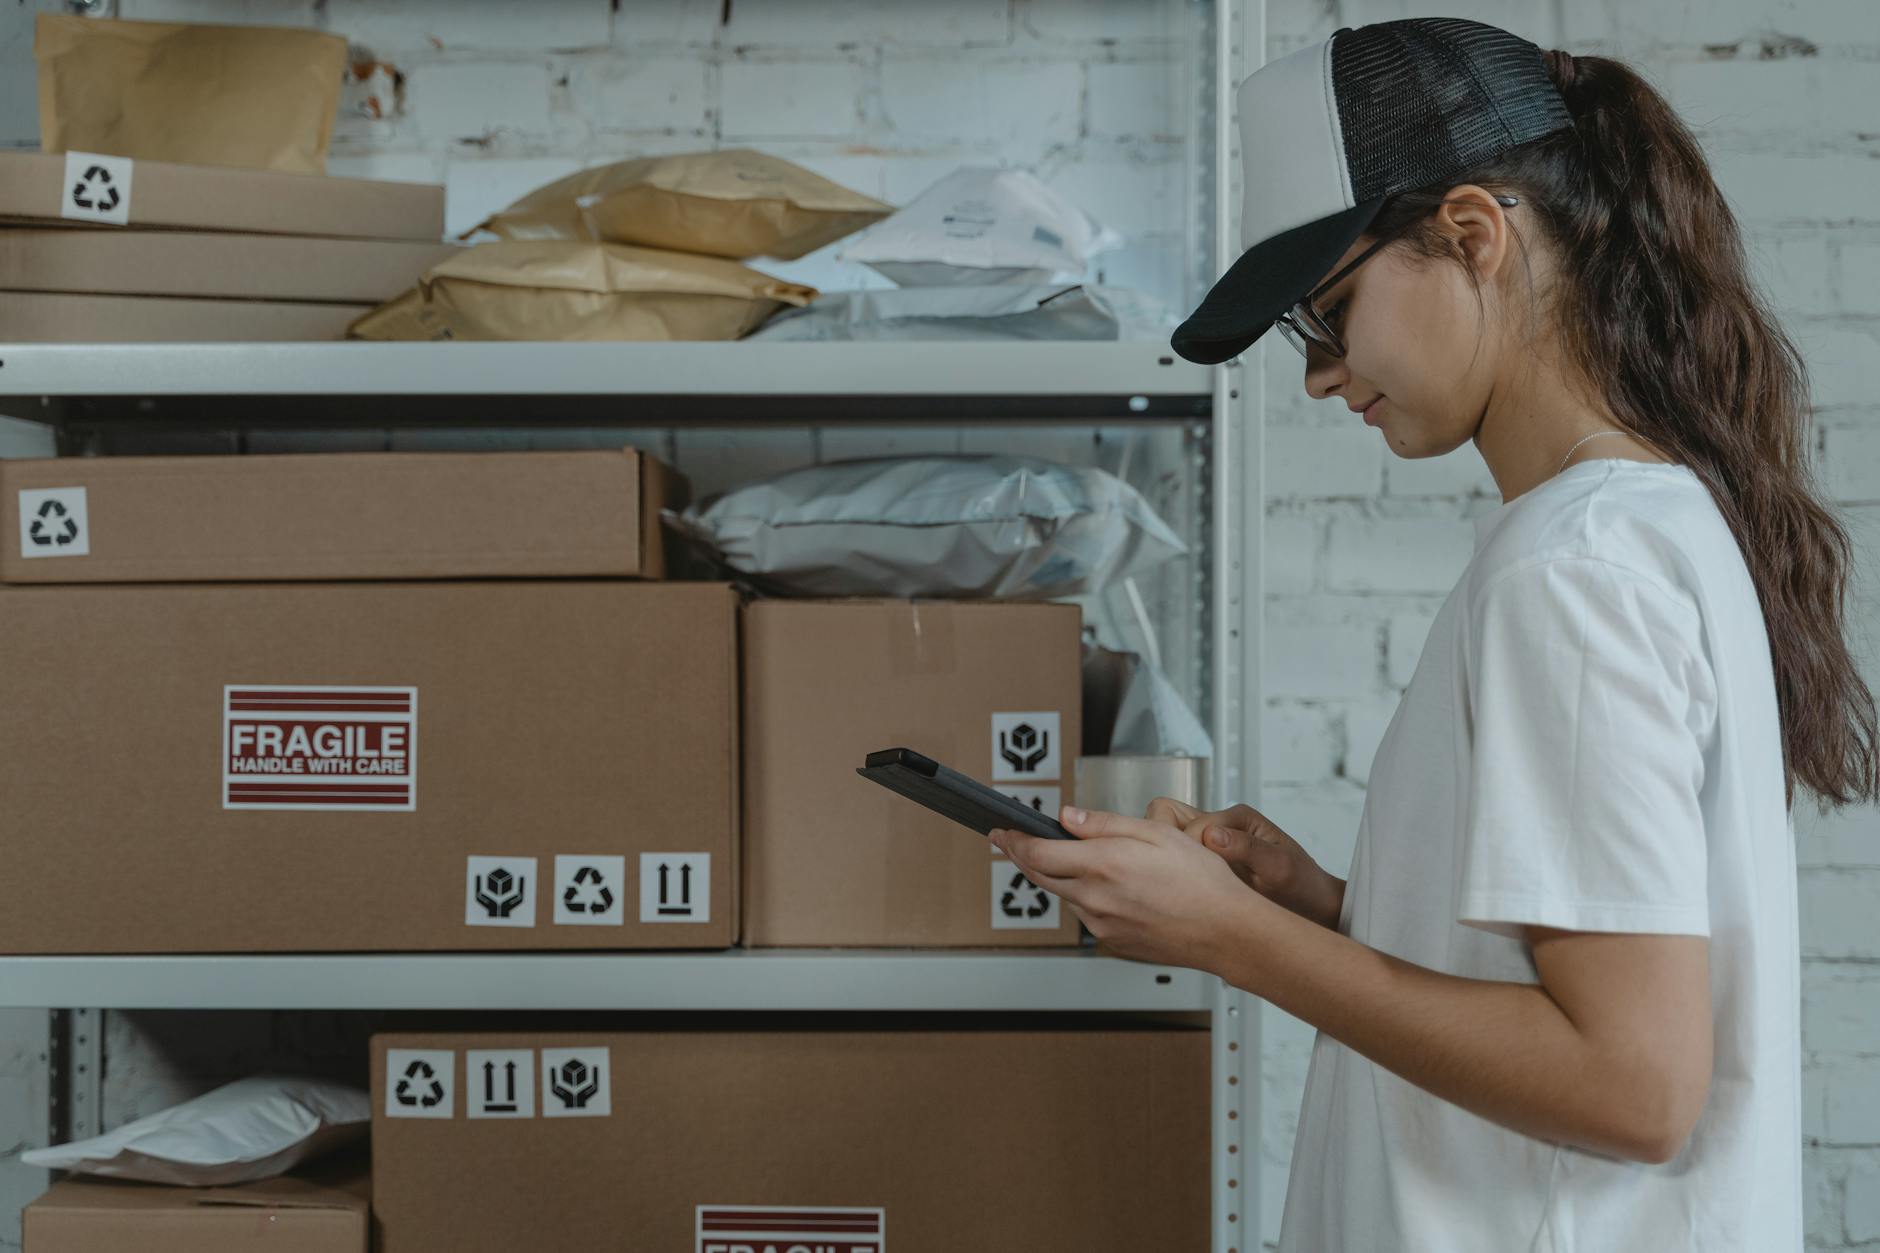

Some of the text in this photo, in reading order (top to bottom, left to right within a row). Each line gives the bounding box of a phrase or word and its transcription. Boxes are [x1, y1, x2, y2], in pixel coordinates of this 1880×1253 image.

[231, 724, 406, 758] FRAGILE
[232, 758, 405, 774] HANDLE WITH CARE
